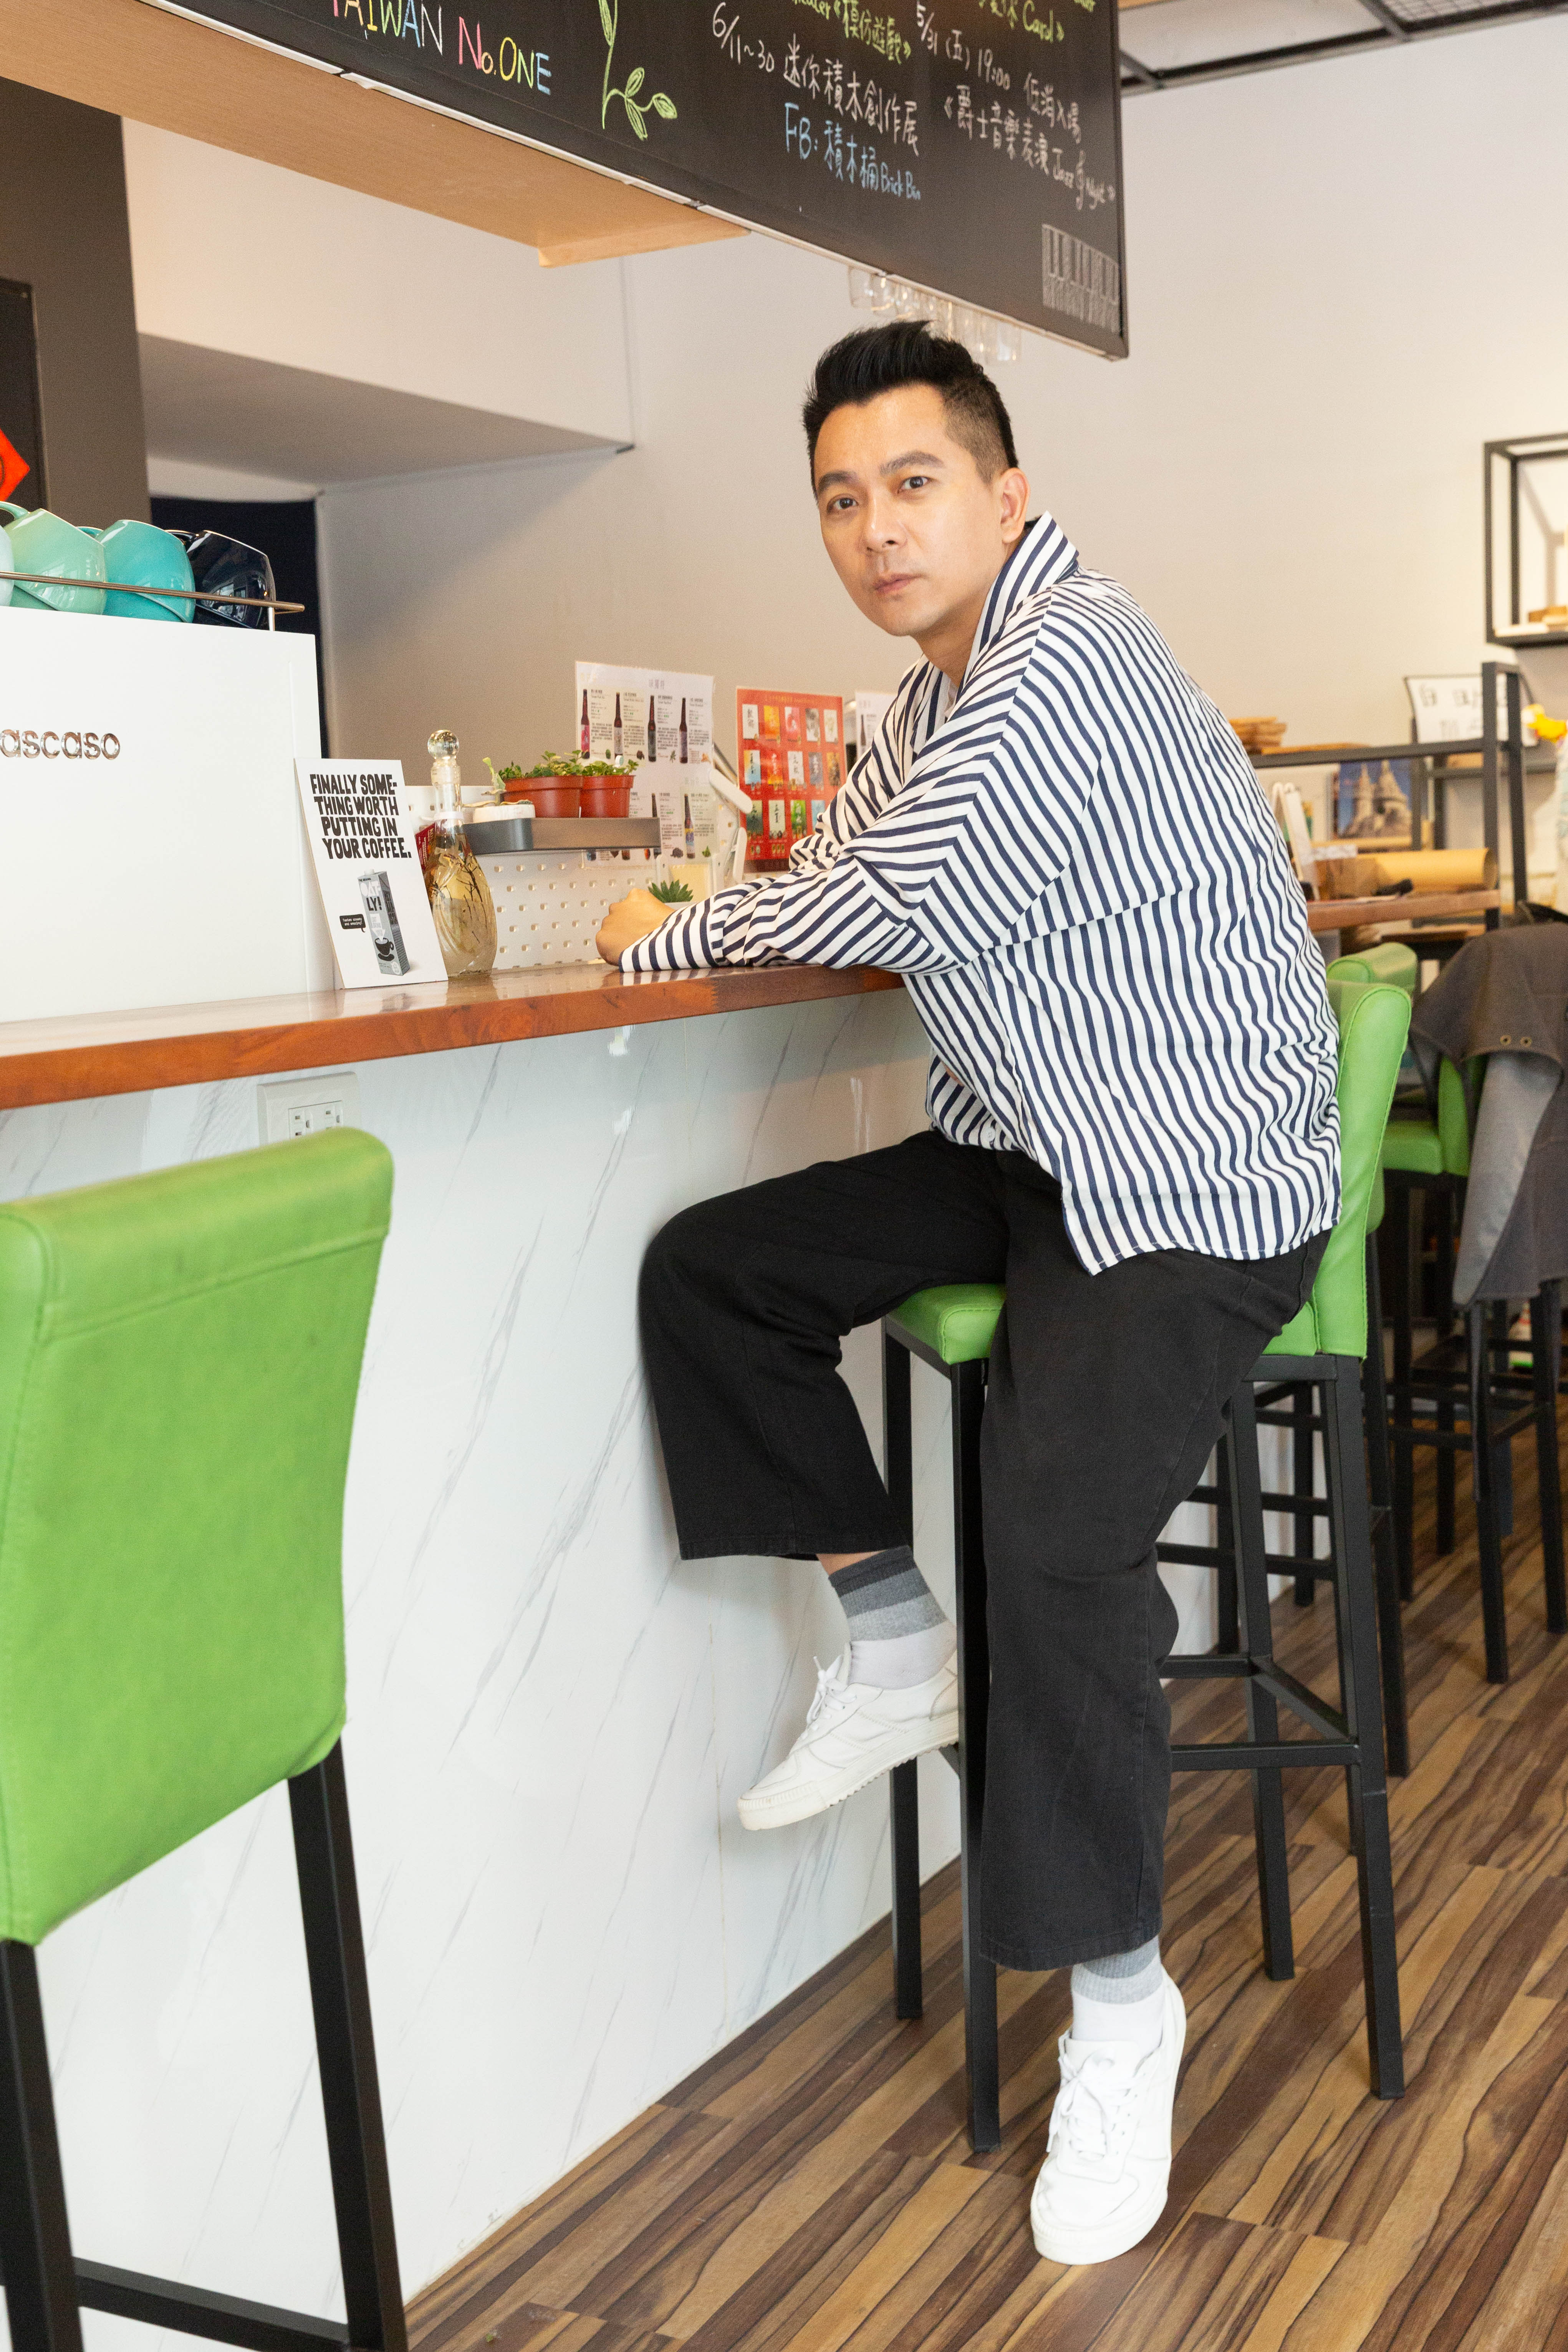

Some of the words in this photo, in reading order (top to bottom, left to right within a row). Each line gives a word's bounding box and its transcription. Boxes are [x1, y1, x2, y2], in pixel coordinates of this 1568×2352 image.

[0, 729, 120, 760] ascaso
[310, 774, 357, 794] FINALLY
[360, 774, 397, 795] SOME-
[314, 796, 352, 815] THING
[353, 797, 399, 816] WORTH
[321, 817, 381, 836] PUTTING
[382, 817, 398, 836] IN
[322, 838, 362, 859] YOUR
[363, 837, 412, 858] COFFEE.
[366, 896, 382, 911] LY!
